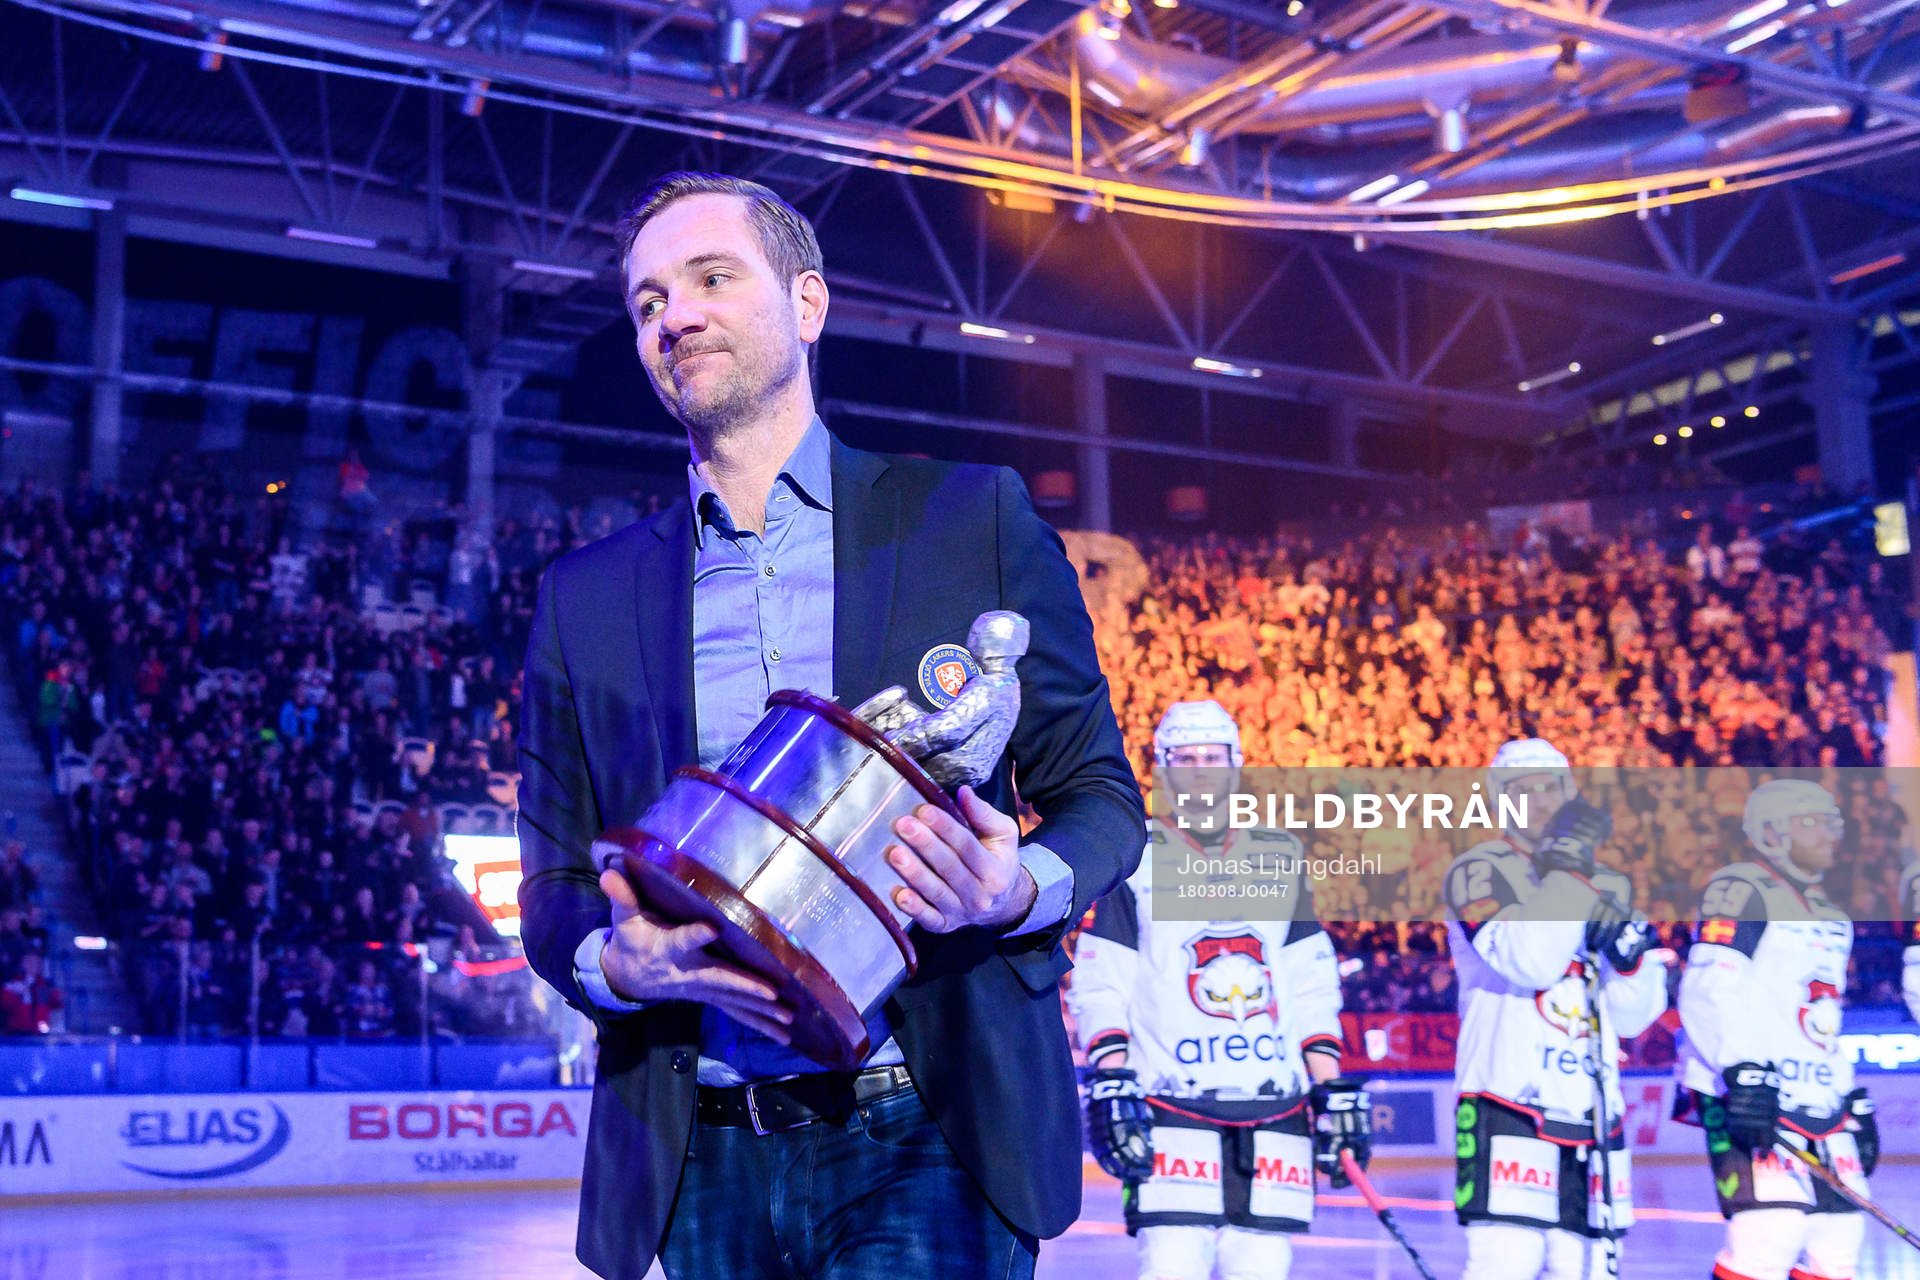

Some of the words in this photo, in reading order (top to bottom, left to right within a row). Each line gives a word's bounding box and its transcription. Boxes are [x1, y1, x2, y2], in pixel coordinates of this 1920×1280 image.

[1452, 860, 1493, 907] 12
[121, 1107, 262, 1146] ELIAS
[348, 1101, 577, 1140] BORGA
[413, 1150, 519, 1172] Stålhallar
